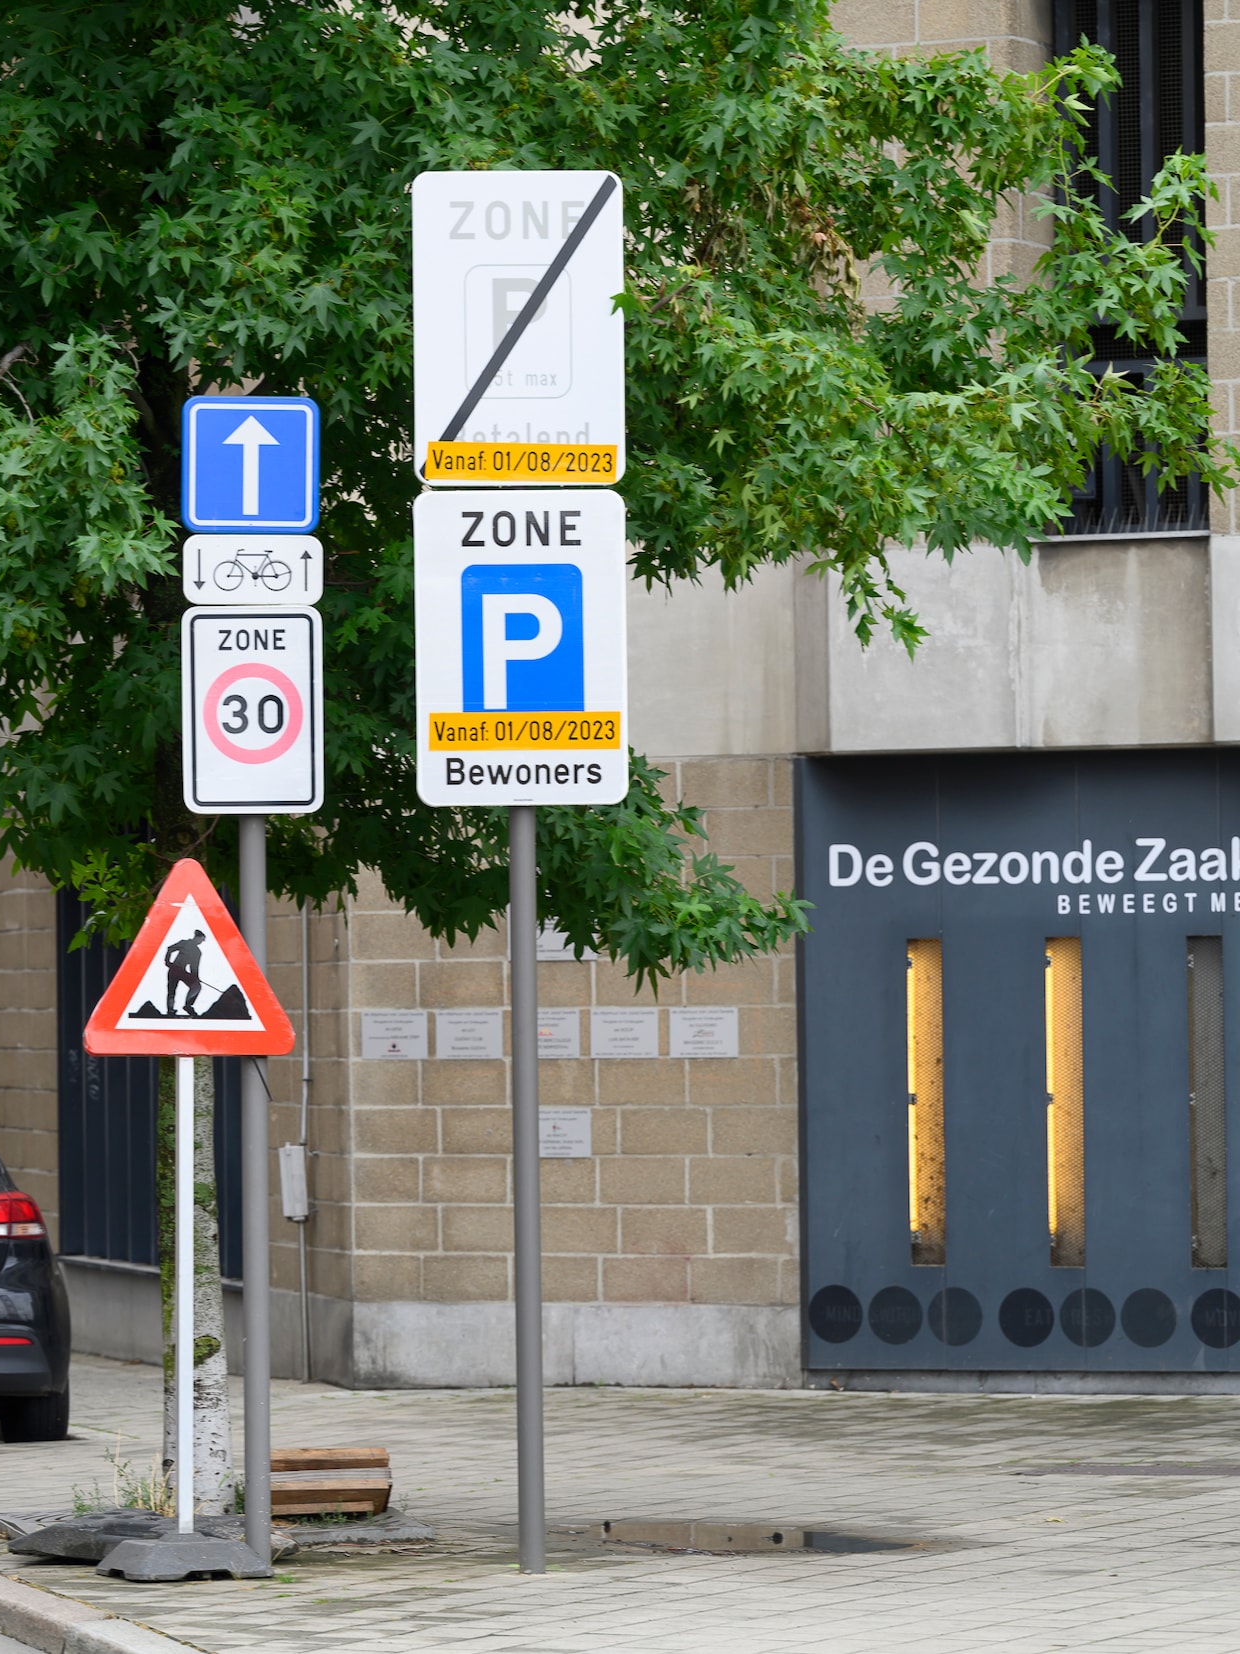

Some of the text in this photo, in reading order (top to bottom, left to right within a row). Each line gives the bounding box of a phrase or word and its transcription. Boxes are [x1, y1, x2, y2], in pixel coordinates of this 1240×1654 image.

[449, 200, 585, 240] ZONE
[526, 373, 558, 387] max
[493, 451, 613, 473] 01/08/2023
[461, 510, 582, 547] ZONE
[218, 629, 287, 651] ZONE
[482, 593, 563, 710] P
[221, 693, 285, 735] 30
[433, 720, 616, 742] Vanaf: 01/08/2023
[446, 757, 602, 786] Bewoners
[828, 843, 894, 887] De
[902, 838, 1125, 886] Gezonde
[1057, 892, 1198, 914] BEWEEGT
